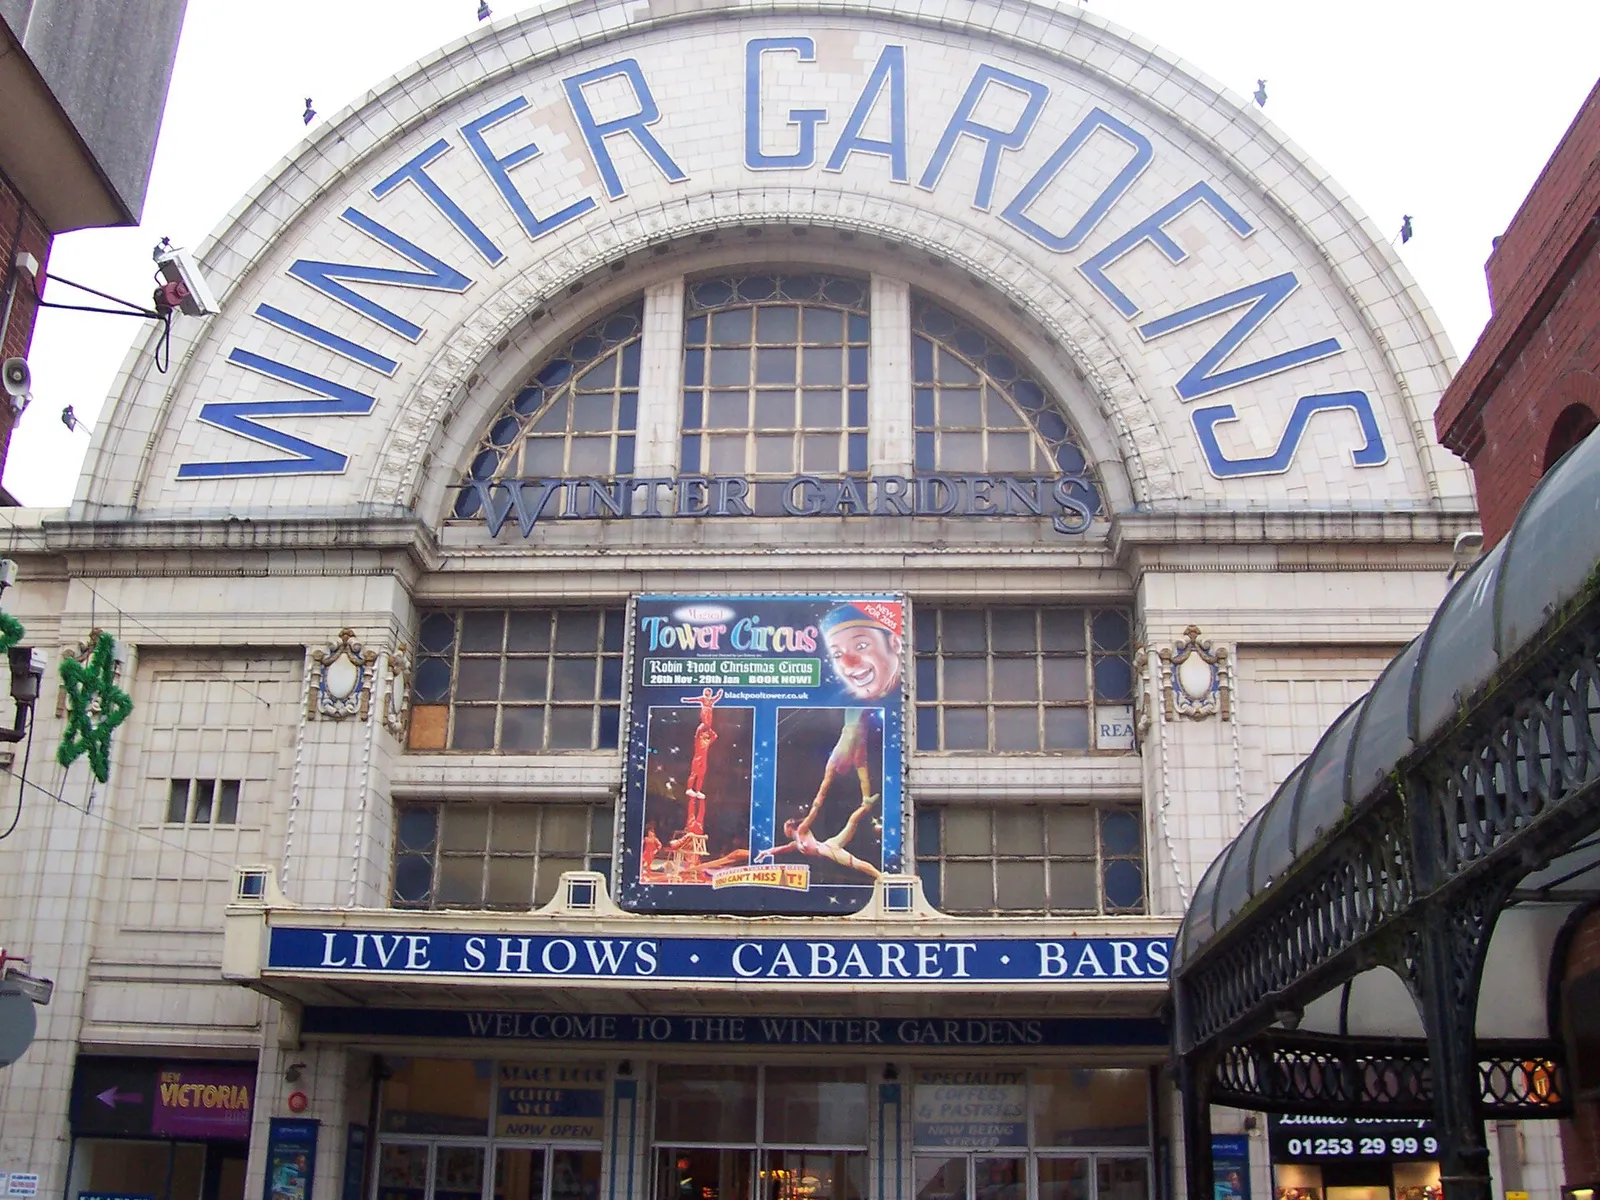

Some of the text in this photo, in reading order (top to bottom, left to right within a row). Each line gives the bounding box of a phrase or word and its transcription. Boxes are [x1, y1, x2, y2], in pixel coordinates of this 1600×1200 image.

[175, 35, 1391, 480] WINTER GARDENS
[472, 475, 1097, 538] WINTER GARDENS
[864, 604, 881, 619] FOR
[875, 603, 896, 619] NEW
[641, 615, 819, 653] Tower Circus
[650, 660, 813, 674] Robin Hood Christmas Circus
[722, 675, 740, 684] Jan
[748, 675, 812, 684] BOOK NOW!
[724, 690, 809, 701] blackpooltower.co.uk
[1100, 724, 1134, 737] REA
[727, 873, 751, 882] CAN'T
[752, 872, 777, 882] MISS
[320, 932, 1170, 977] LIVE SHOWS CABARET BARS
[466, 1013, 1043, 1044] WELCOME TO THE WINTER GARDENS
[160, 1083, 249, 1110] VICTORIA
[506, 1123, 595, 1137] NOW OPEN
[928, 1124, 1014, 1137] NOW BEING
[1288, 1138, 1353, 1155] 01253
[1359, 1137, 1386, 1154] 29
[1391, 1137, 1418, 1154] 99
